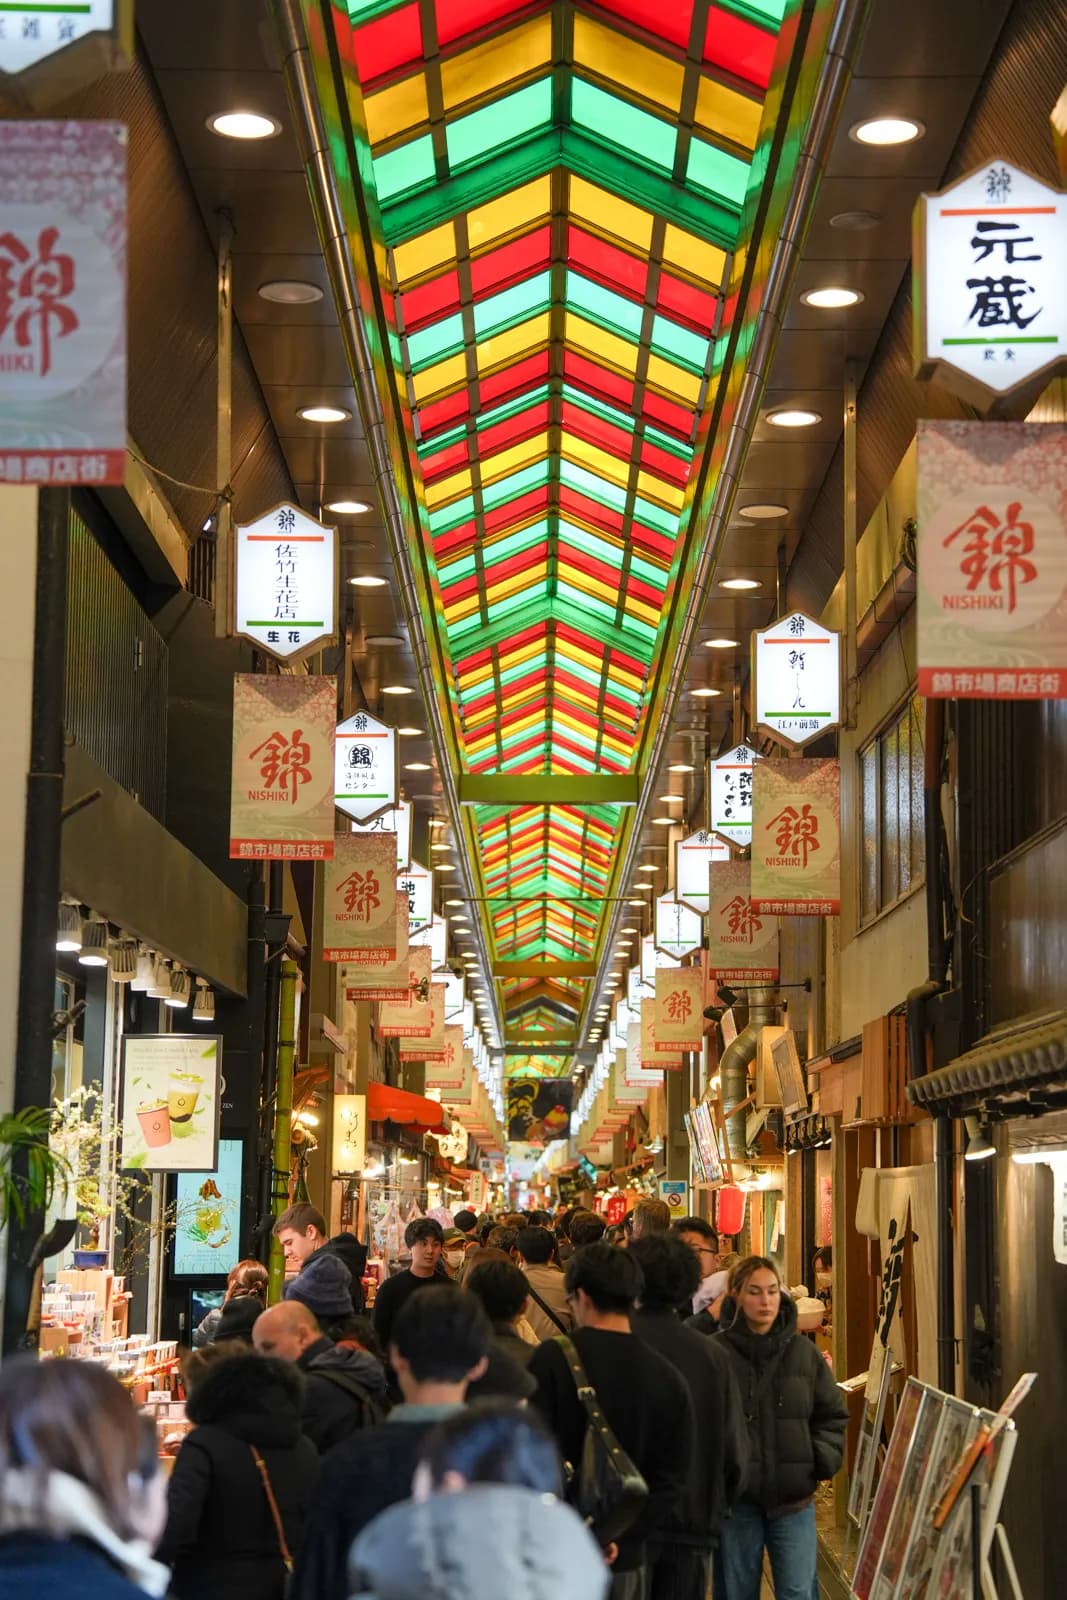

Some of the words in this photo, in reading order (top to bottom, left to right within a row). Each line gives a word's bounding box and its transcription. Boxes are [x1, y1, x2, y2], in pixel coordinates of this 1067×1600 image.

[966, 221, 1043, 329] 元蔵
[274, 509, 295, 534] 錦
[942, 502, 1038, 614] 錦
[274, 543, 298, 619] 佐竹生花店
[942, 595, 1004, 609] NISHIKI
[267, 631, 300, 643] 生花
[932, 673, 1060, 694] 錦市場商店街
[350, 746, 371, 765] 錦
[249, 729, 312, 805] 錦
[248, 790, 288, 801] NISHIKI
[765, 804, 820, 870] 錦
[239, 842, 324, 857] 錦市場商店街
[765, 857, 800, 866] NISHIKI
[336, 870, 381, 923] 錦
[335, 913, 364, 921] NISHIKI
[760, 902, 832, 914] 錦市場商店街
[719, 896, 763, 944] 錦
[719, 935, 748, 943] NISHIKI
[330, 951, 389, 960] 錦市場商店街
[716, 970, 773, 980] 錦市場商店街
[662, 990, 692, 1025] 錦
